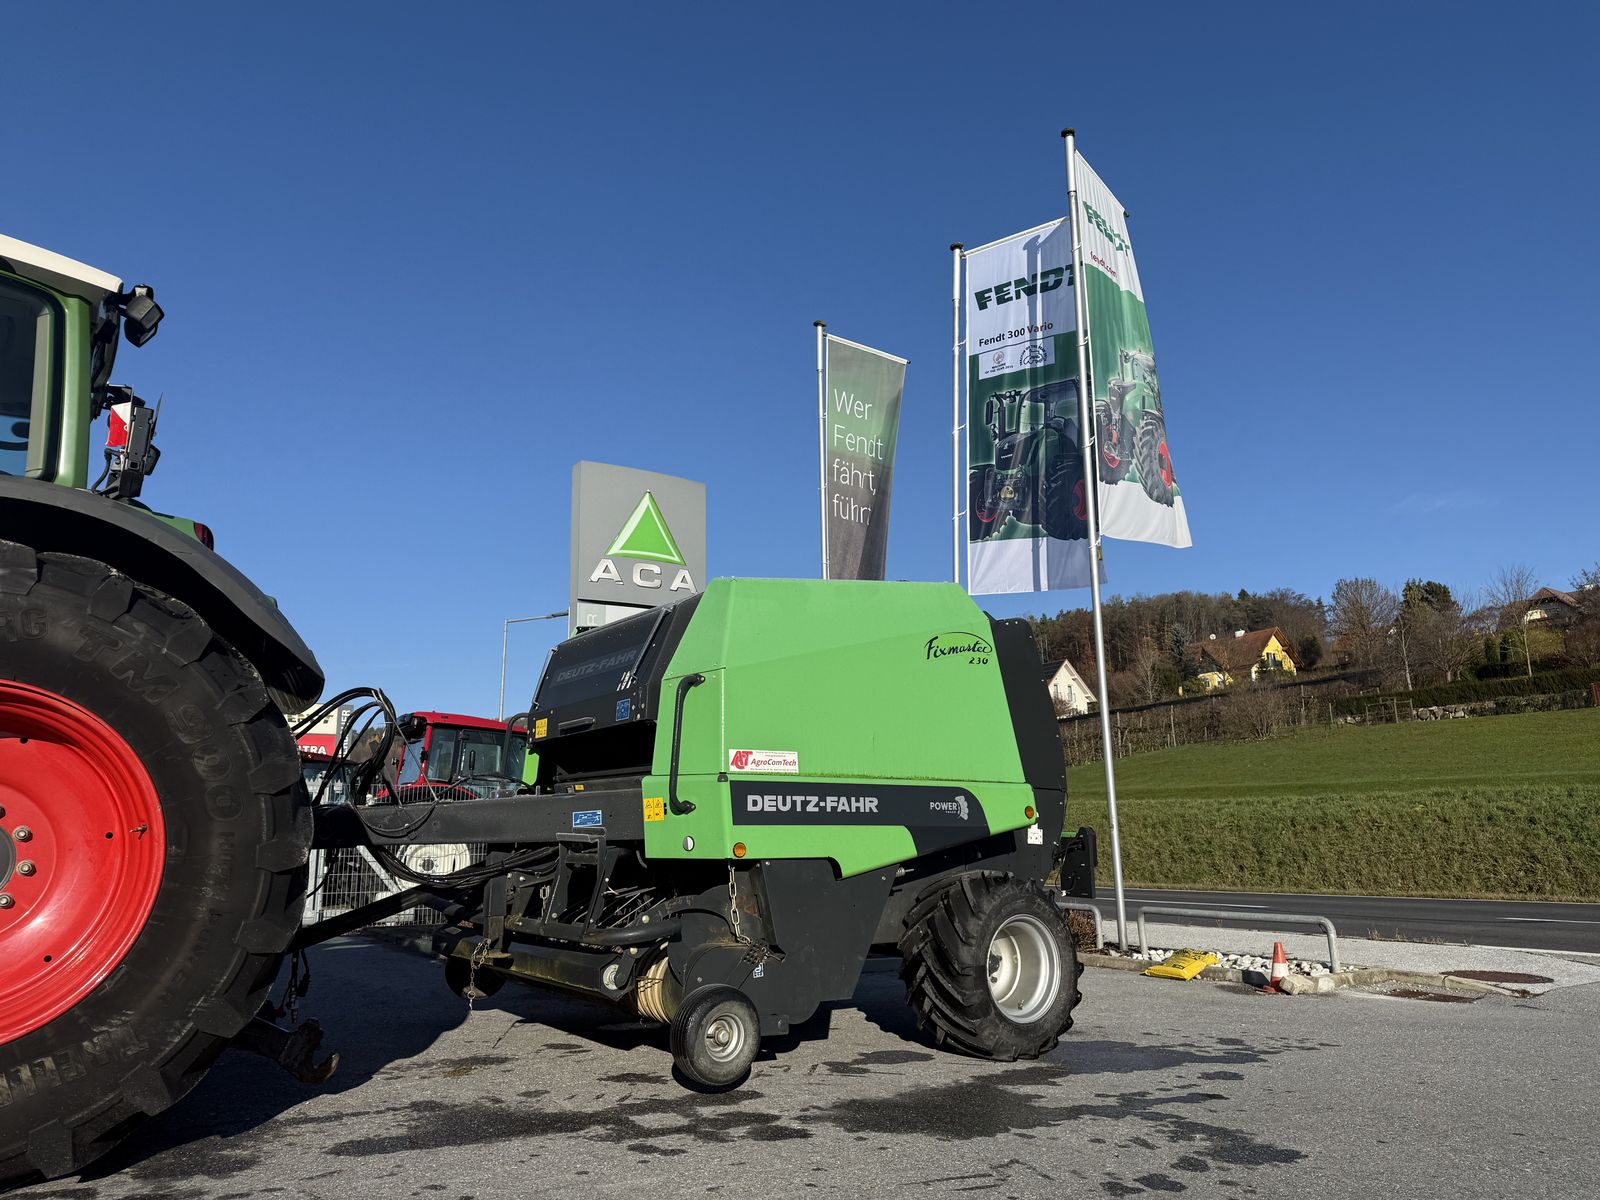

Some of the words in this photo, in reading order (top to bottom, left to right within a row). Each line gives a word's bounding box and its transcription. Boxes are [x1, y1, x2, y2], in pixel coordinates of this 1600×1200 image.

[1082, 200, 1130, 257] FENDT
[974, 261, 1083, 311] FENDT
[979, 333, 1005, 347] Fendt
[1007, 327, 1025, 339] 300
[1027, 322, 1053, 334] Vario
[833, 388, 872, 420] Wer
[834, 424, 884, 460] Fendt
[833, 459, 876, 495] fährt,
[588, 558, 698, 595] ACA
[924, 631, 993, 660] Fixmaster
[968, 656, 989, 665] 230
[557, 649, 637, 682] DEUTZ-FAHR
[750, 758, 797, 768] AgroComTech
[747, 794, 879, 813] DEUTZ-FAHR
[930, 801, 958, 811] POWER
